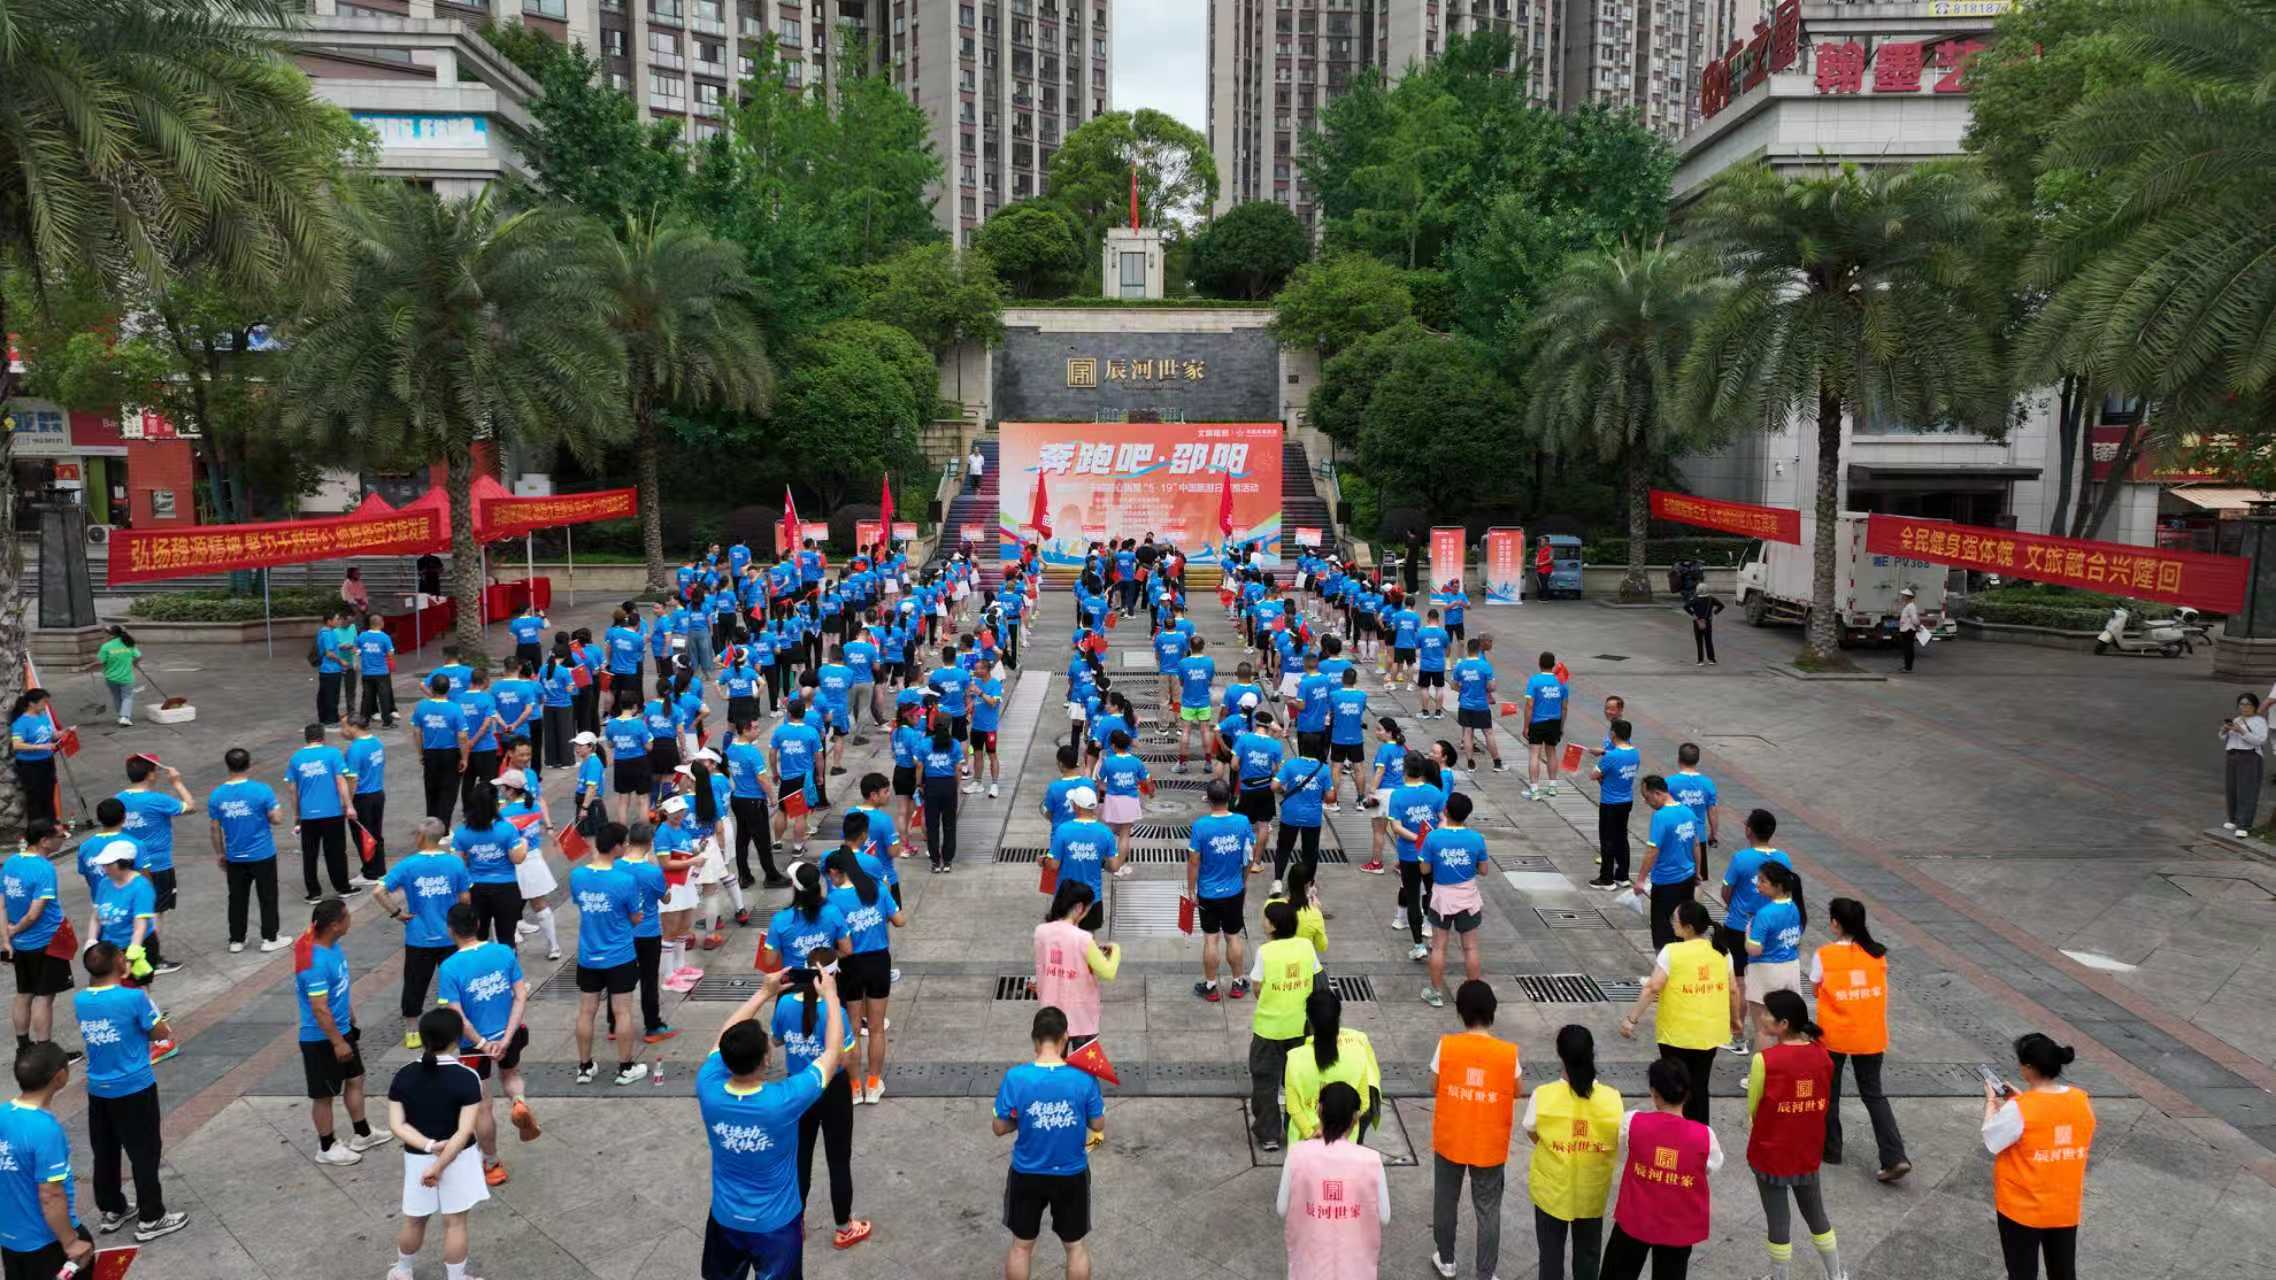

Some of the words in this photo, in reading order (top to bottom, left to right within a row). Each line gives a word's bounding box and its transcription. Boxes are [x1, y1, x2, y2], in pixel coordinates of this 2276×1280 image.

[1104, 359, 1207, 383] 辰河世家
[1901, 525, 2015, 568] 全民健身强体魄
[2024, 544, 2184, 594] 文旅融合兴隆回
[1448, 1084, 1499, 1104] 辰河世家
[1026, 1100, 1075, 1116] 我运动
[1776, 1098, 1827, 1113] 辰河世家
[712, 1121, 764, 1141] 我运动
[1032, 1112, 1077, 1131] 我快乐
[720, 1136, 775, 1154] 我快乐
[1634, 1162, 1695, 1189] 辰河世家
[1306, 1202, 1361, 1220] 辰河世家
